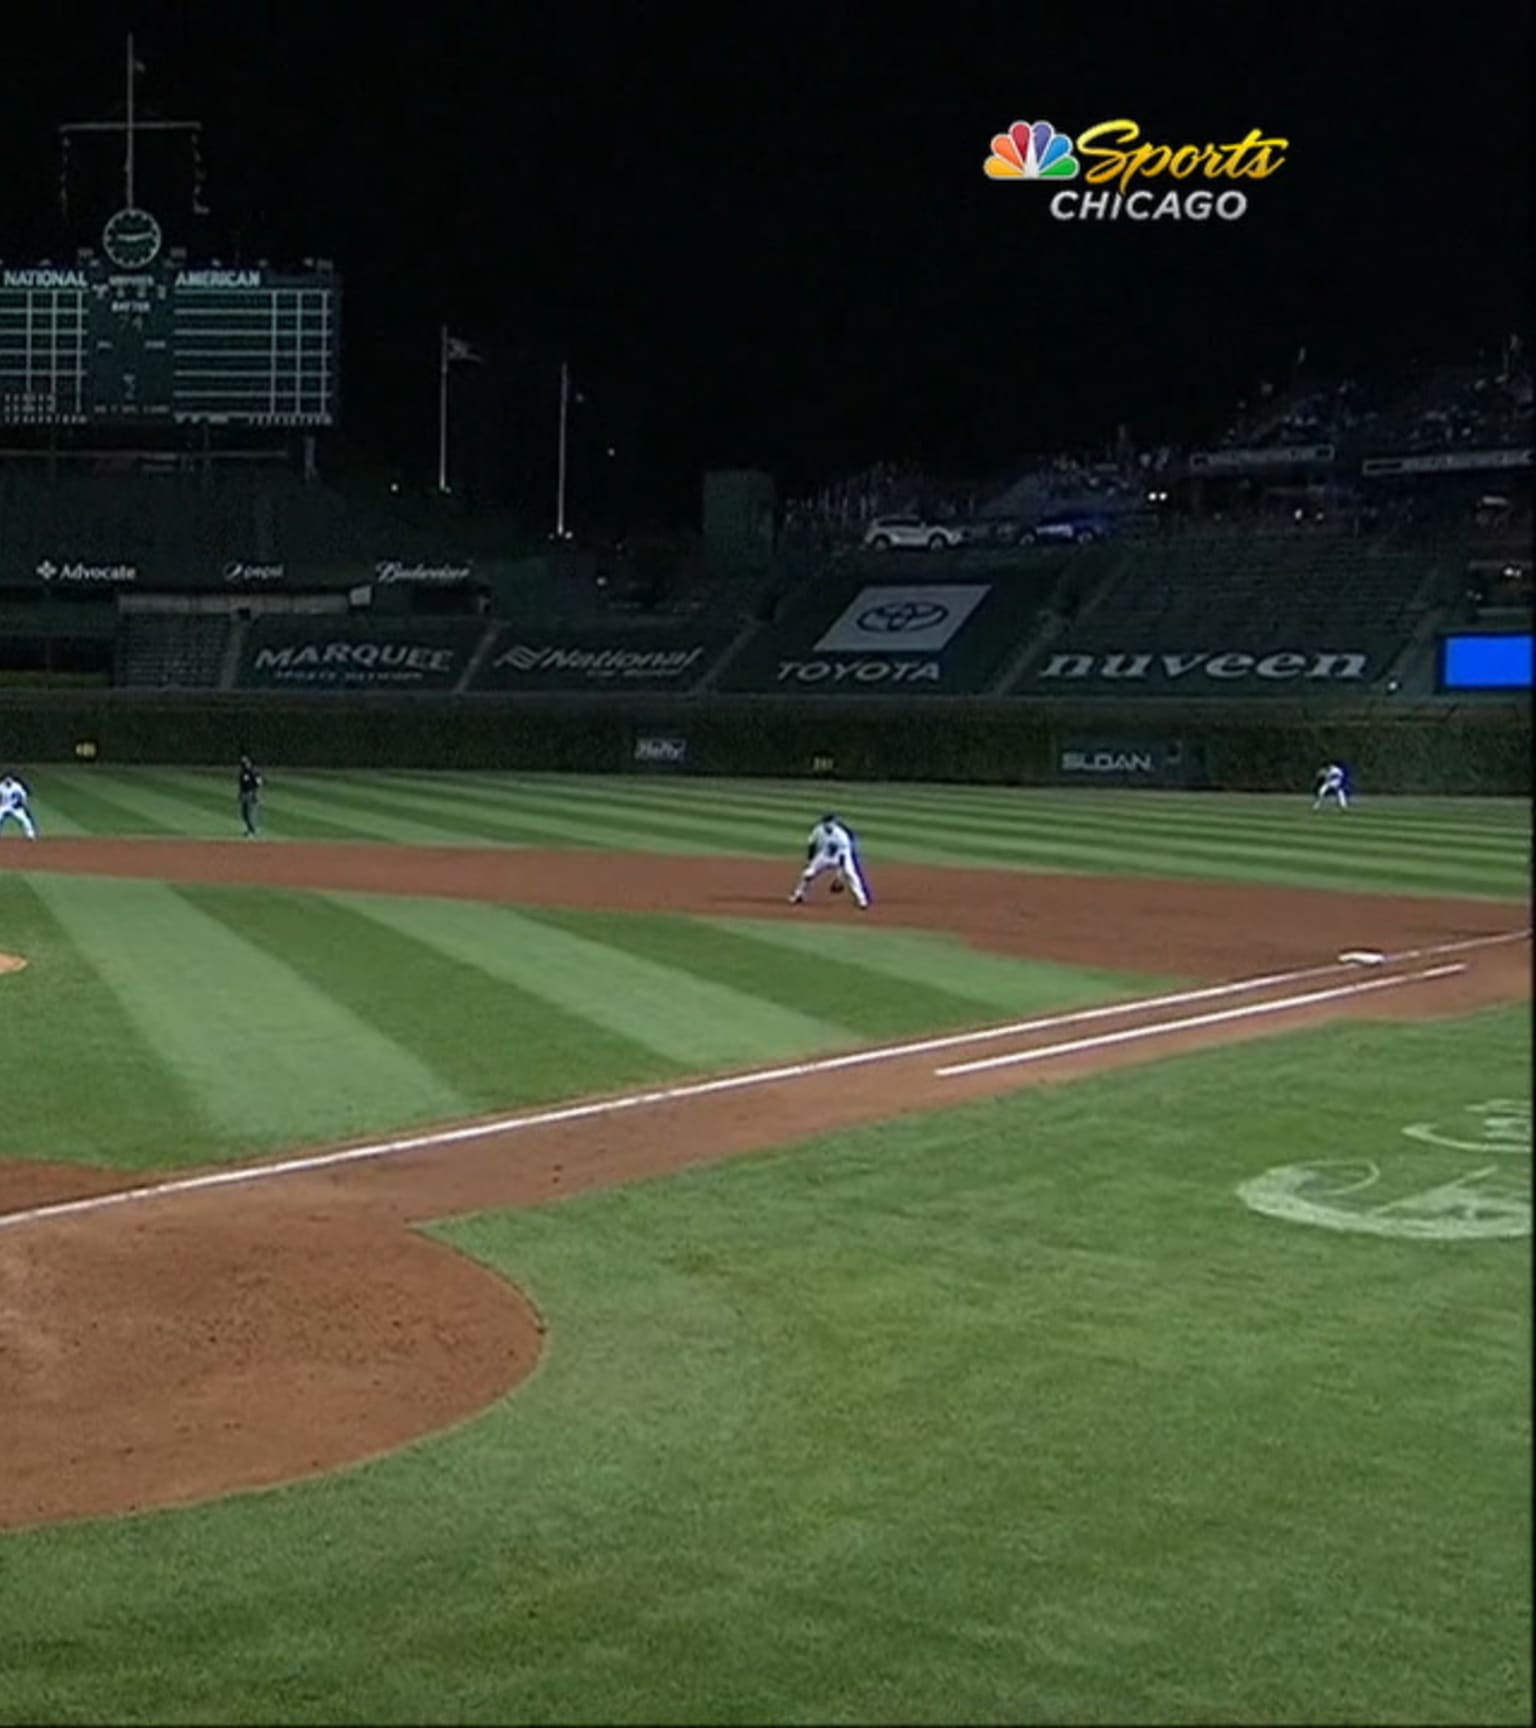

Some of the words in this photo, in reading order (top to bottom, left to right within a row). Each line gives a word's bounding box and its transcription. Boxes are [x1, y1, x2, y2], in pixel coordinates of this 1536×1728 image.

[3, 270, 89, 288] NATIONAL
[174, 270, 261, 289] AMERICAN
[60, 563, 137, 581] Advocate
[375, 560, 471, 583] Budweiser
[254, 642, 455, 673] MARQUEE
[538, 645, 705, 671] National
[1040, 650, 1368, 680] nuveen
[777, 659, 942, 683] TOYOTA
[1062, 751, 1152, 771] SLOAN
